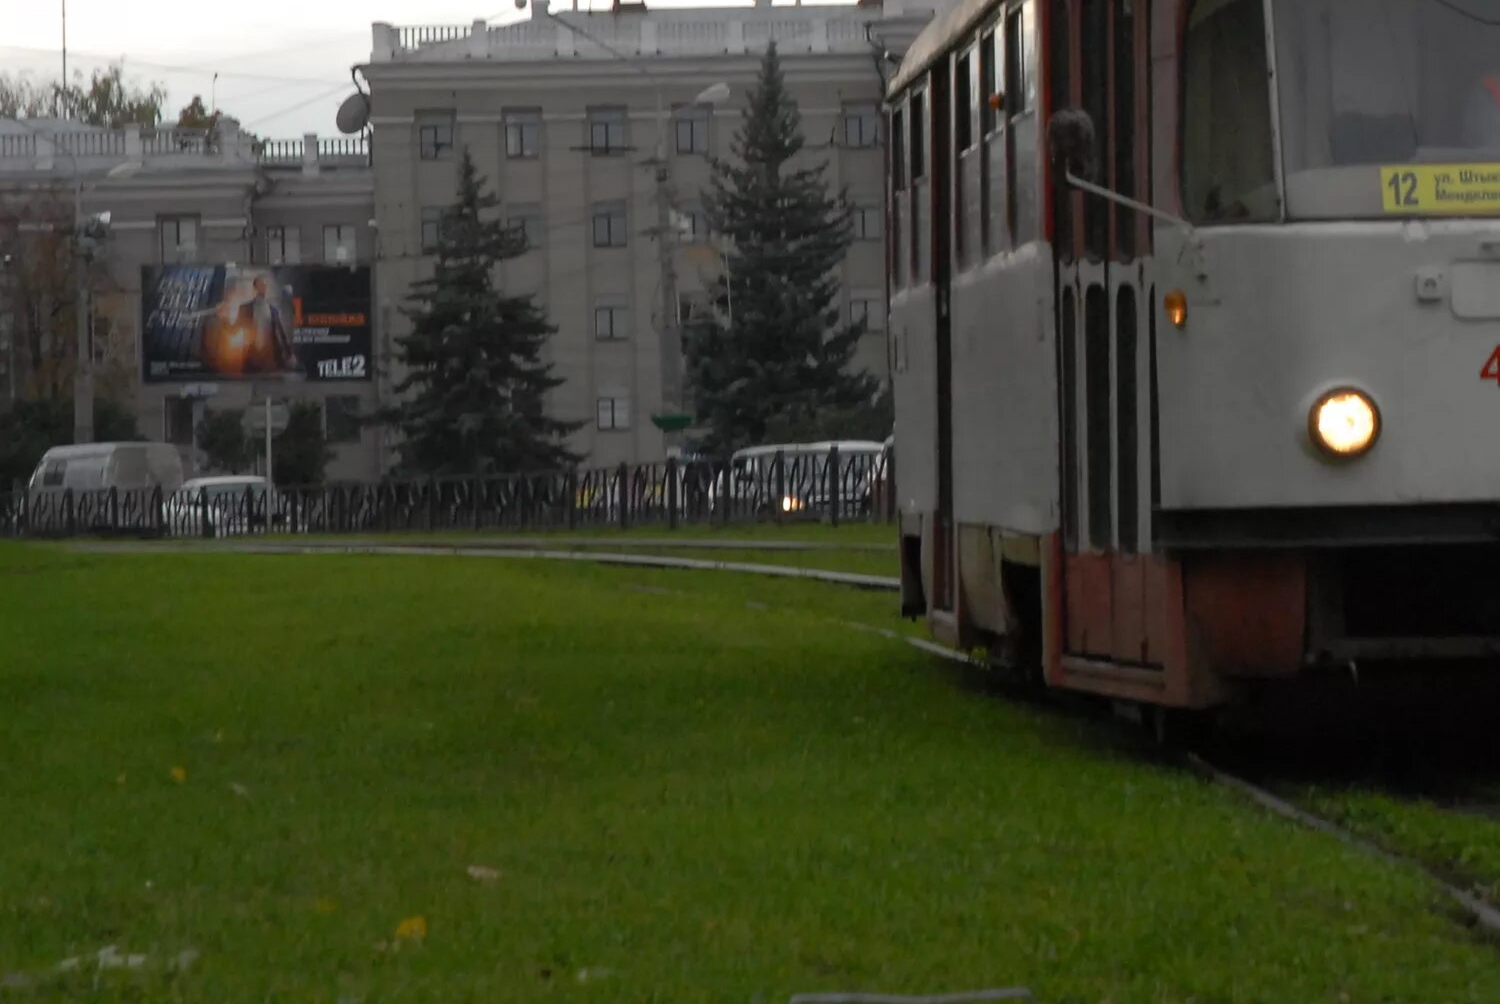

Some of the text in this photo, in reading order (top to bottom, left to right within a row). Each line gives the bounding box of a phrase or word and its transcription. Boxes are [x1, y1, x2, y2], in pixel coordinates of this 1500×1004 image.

[1388, 171, 1419, 206] 12
[1434, 172, 1454, 186] ул.
[317, 354, 365, 377] TELE2
